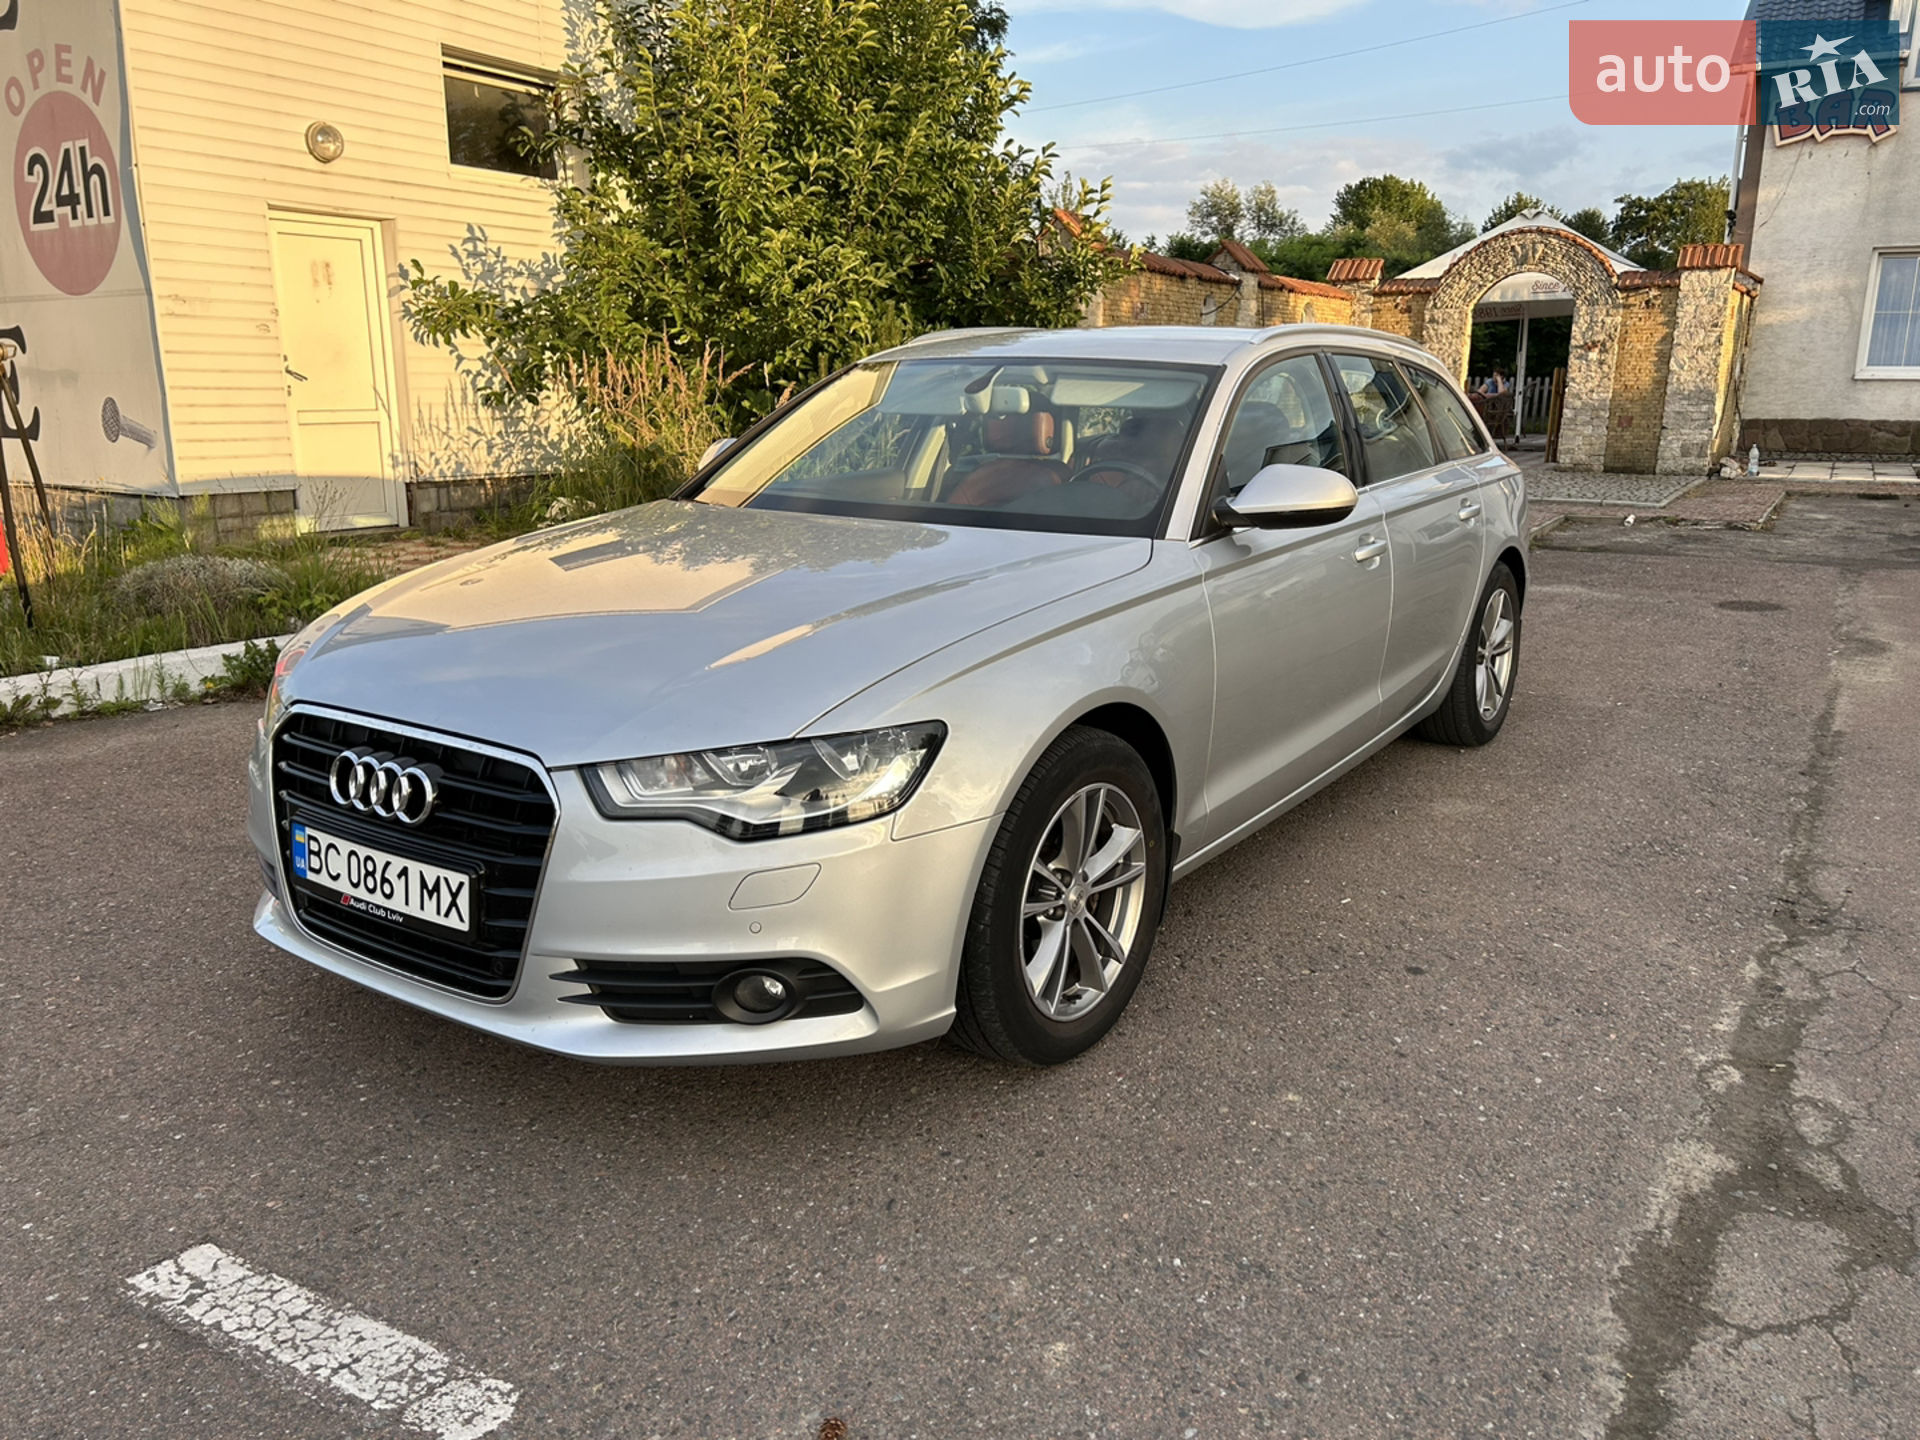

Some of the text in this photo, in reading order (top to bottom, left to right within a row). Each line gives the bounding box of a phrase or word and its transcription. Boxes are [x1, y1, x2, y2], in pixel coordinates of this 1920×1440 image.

[4, 43, 106, 117] OPEN
[26, 141, 113, 227] 24h
[1531, 279, 1560, 291] Since
[347, 849, 410, 907] 0861
[350, 898, 404, 923] Audi Club Lviv
